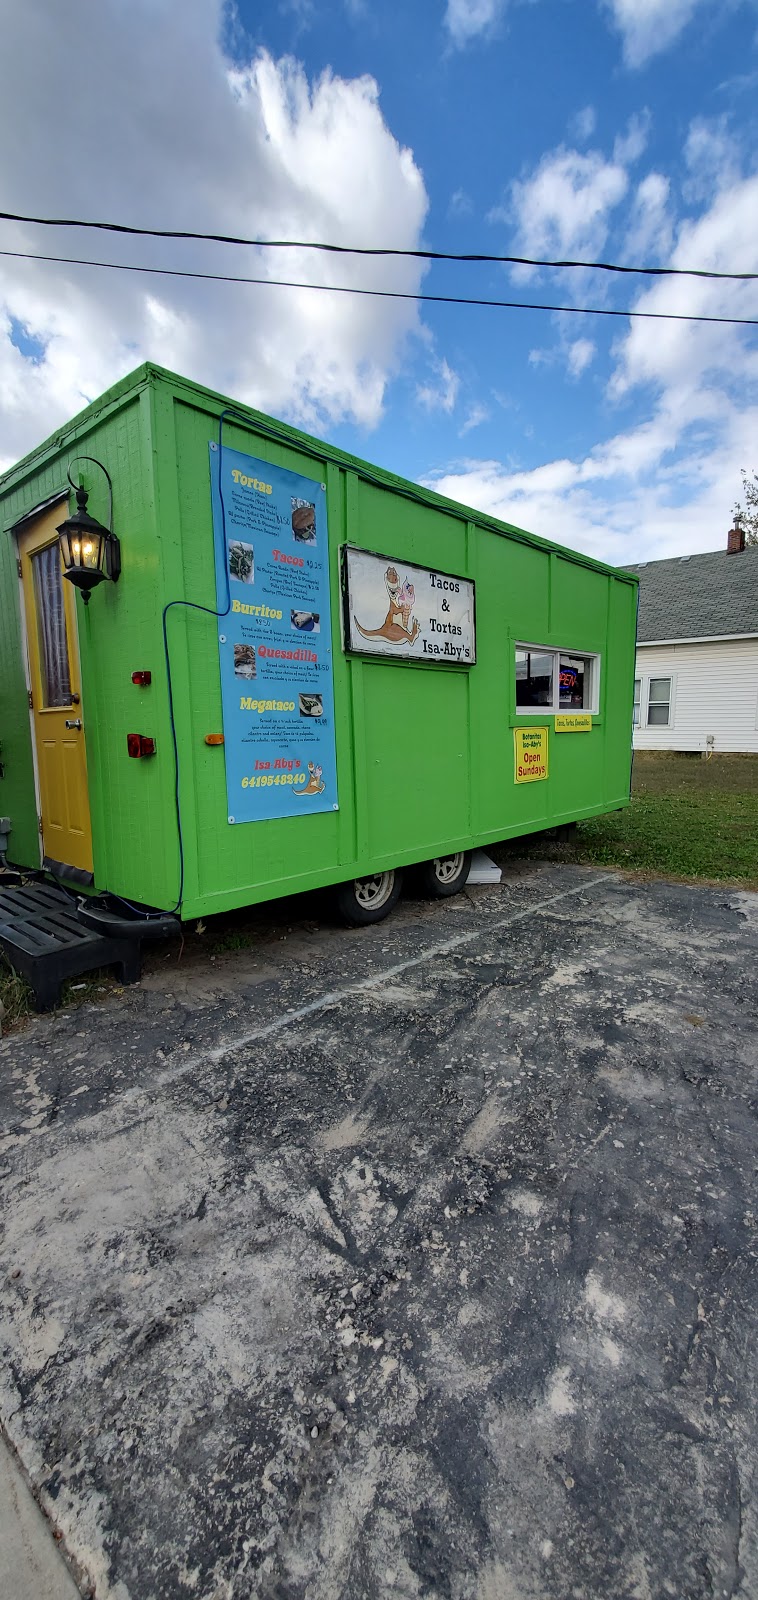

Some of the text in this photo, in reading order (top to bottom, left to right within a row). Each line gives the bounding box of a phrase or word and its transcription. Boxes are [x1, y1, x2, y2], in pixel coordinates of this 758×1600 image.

[232, 469, 272, 494] Tortas
[272, 549, 304, 567] Tacos
[430, 574, 459, 593] Tacos
[232, 599, 282, 620] Burritos
[441, 599, 450, 612] &
[430, 618, 462, 635] Tortas
[258, 645, 317, 663] Quesadilla
[423, 640, 469, 659] Isa-Aby's
[240, 697, 295, 714] Megataco
[255, 758, 301, 771] Isa-Aby's
[524, 753, 540, 764] Open
[518, 765, 545, 776] Sundays
[242, 773, 305, 788] 6419548240
